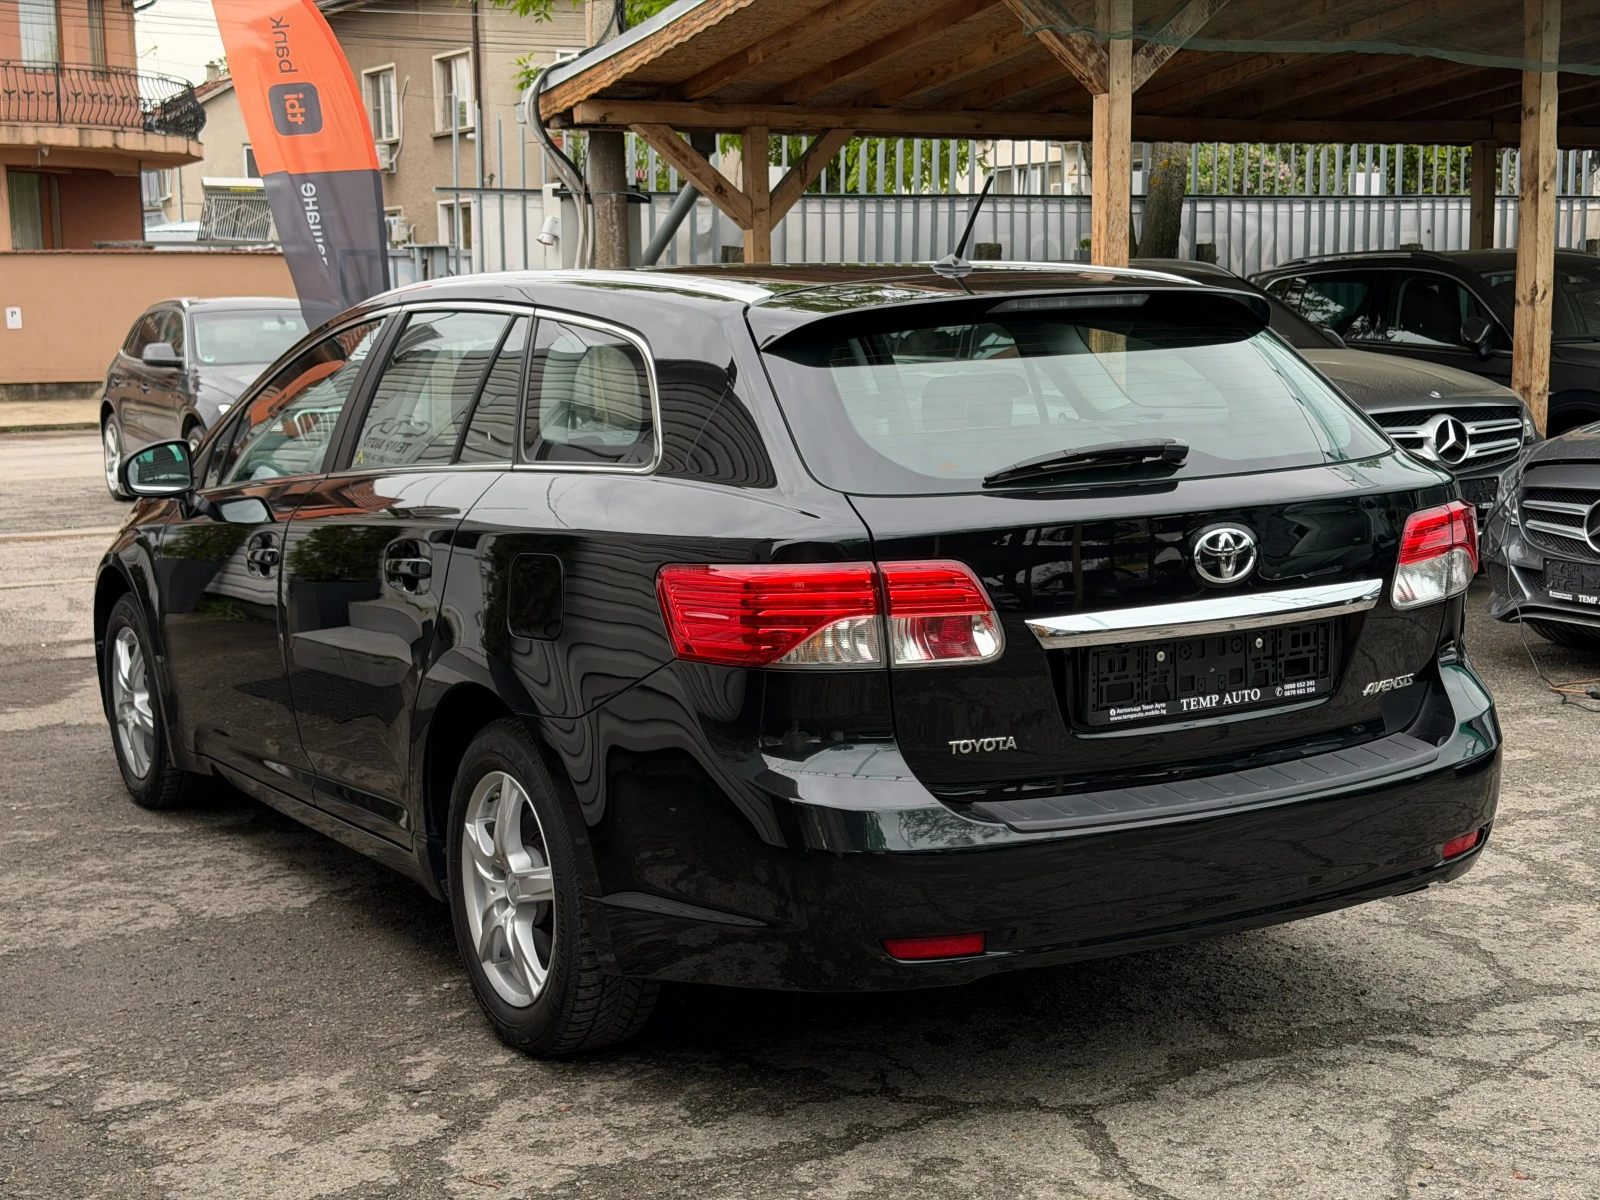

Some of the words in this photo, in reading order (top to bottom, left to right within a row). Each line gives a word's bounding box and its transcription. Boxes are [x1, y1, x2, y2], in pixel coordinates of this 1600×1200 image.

[1578, 594, 1598, 604] TEMP
[1361, 672, 1414, 697] AVENSIS
[1181, 694, 1220, 711] TEMP
[1223, 688, 1261, 706] AUTO
[948, 736, 1018, 755] TOYOTA
